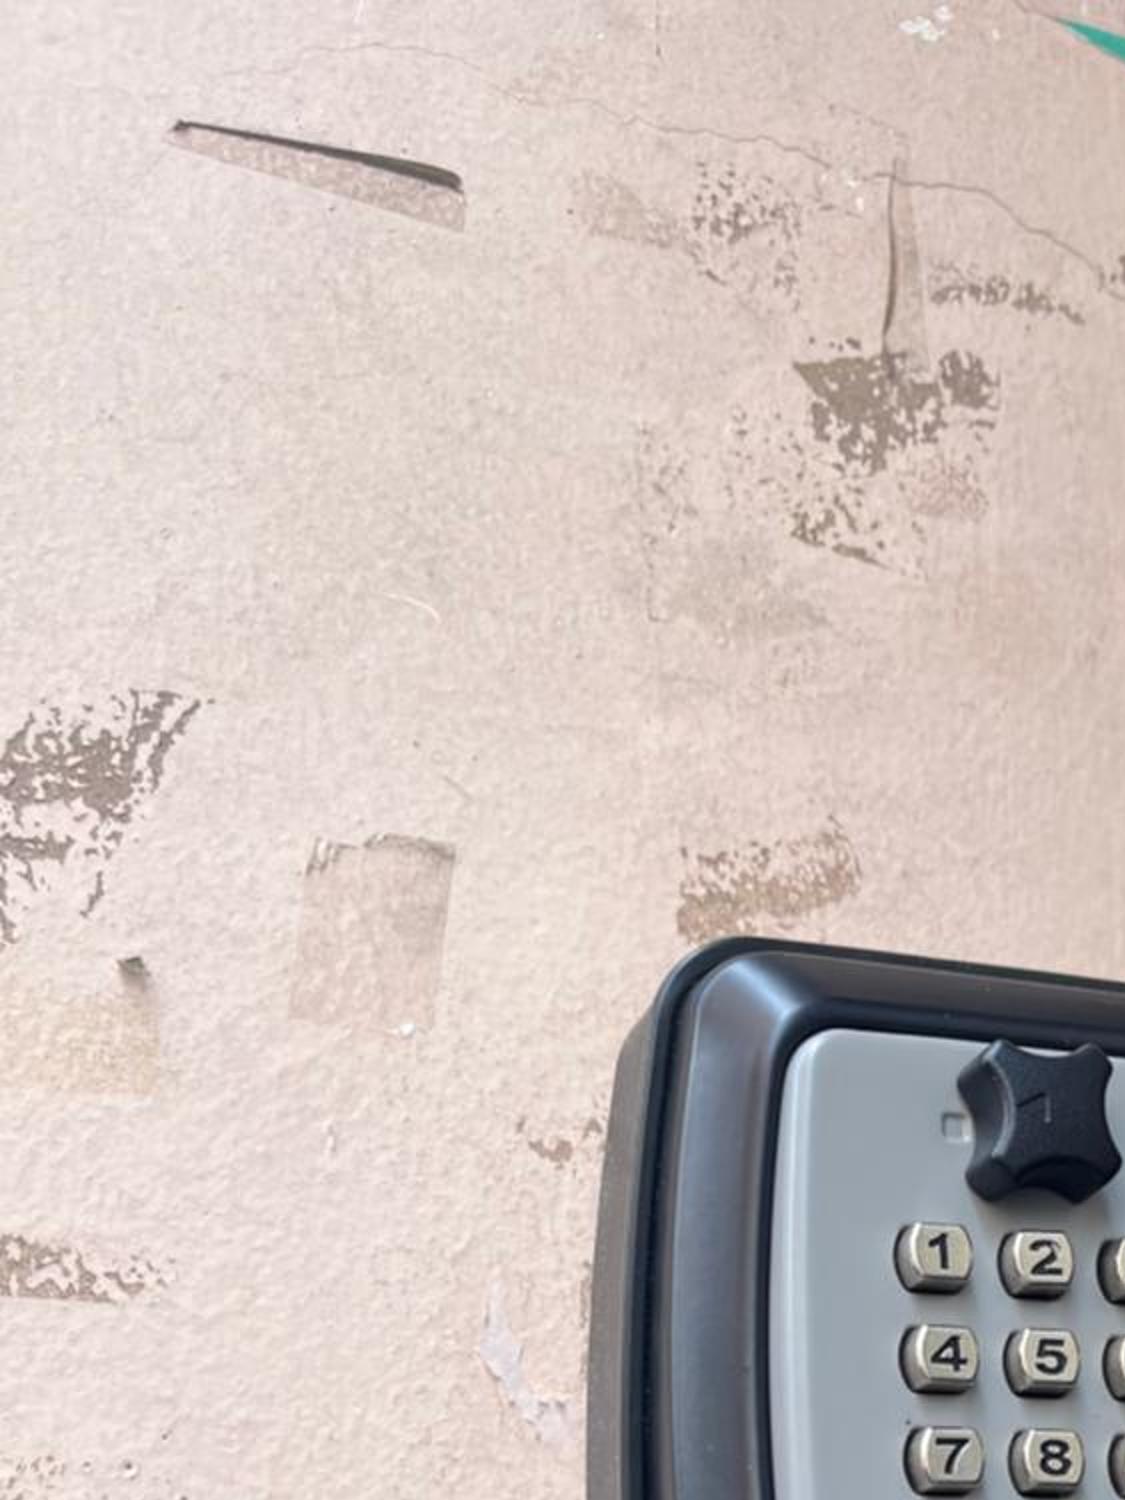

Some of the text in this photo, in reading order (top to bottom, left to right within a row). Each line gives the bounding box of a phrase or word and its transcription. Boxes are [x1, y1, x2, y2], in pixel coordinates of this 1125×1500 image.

[929, 1233, 948, 1269] 1
[1030, 1240, 1062, 1275] 2
[931, 1336, 967, 1371] 4
[1036, 1339, 1067, 1374] 5
[936, 1438, 969, 1473] 7
[1040, 1440, 1071, 1475] 8
